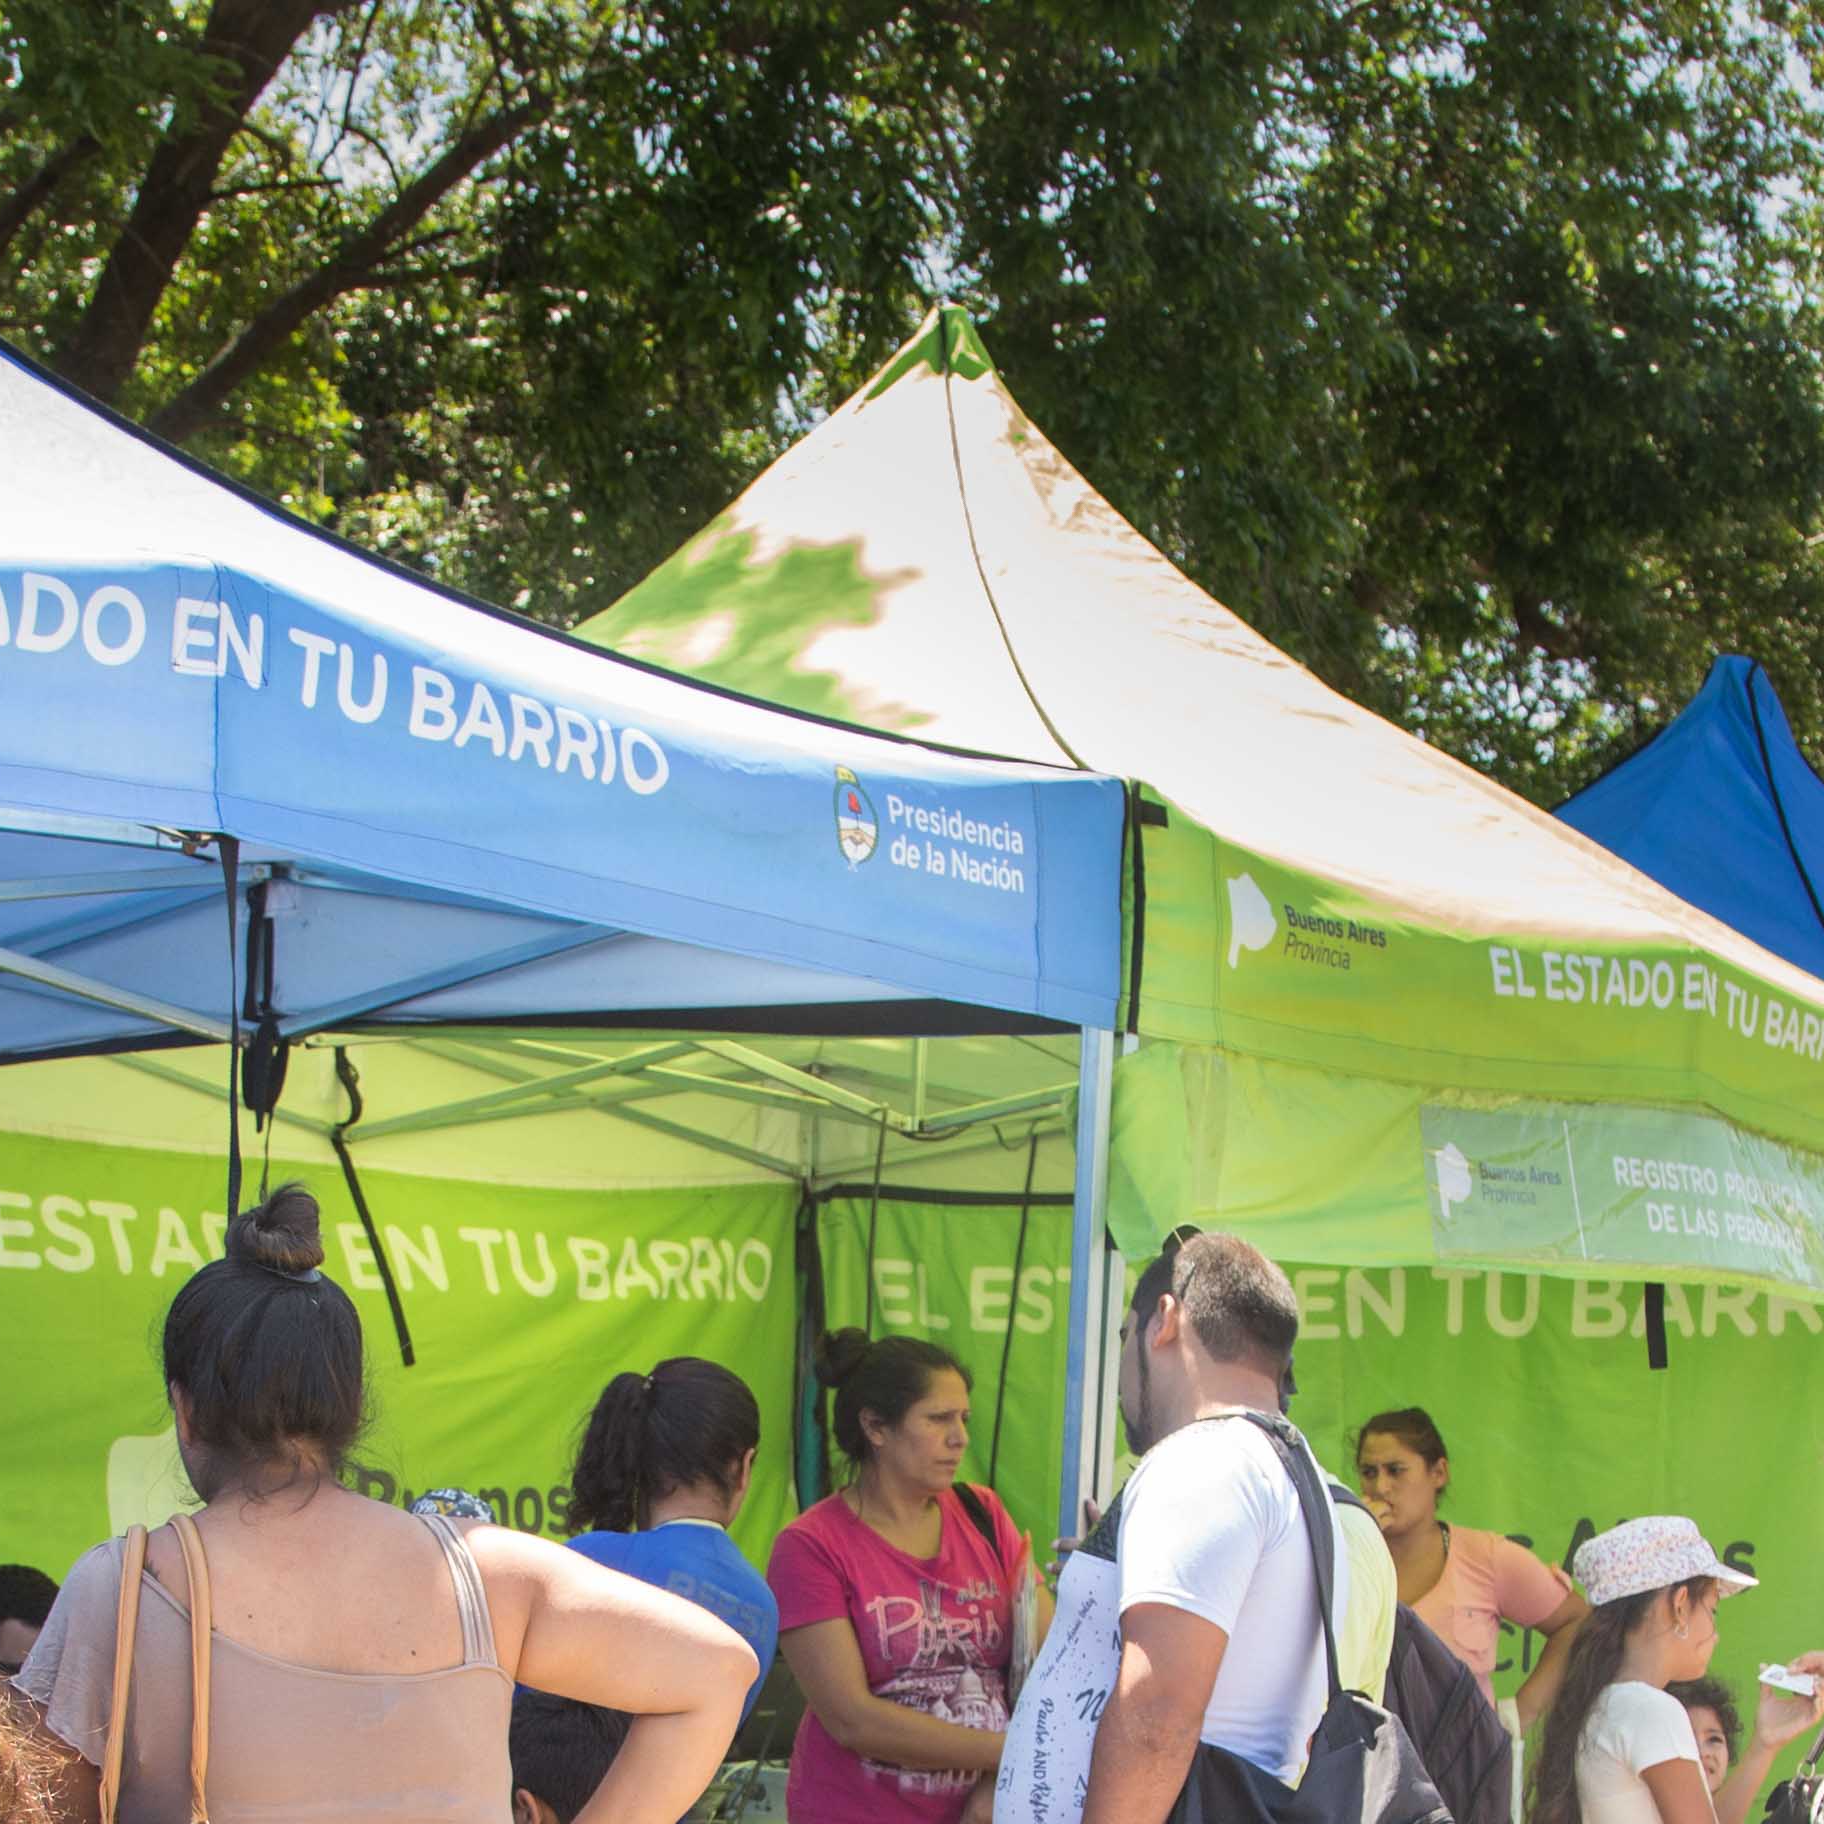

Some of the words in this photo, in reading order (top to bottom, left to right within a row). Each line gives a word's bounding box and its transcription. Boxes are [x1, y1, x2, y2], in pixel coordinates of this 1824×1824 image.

[171, 599, 266, 690] EN
[288, 627, 387, 723] TU
[409, 665, 670, 796] BARRIO
[886, 794, 1024, 855] Presidencia
[890, 834, 921, 869] de
[926, 841, 945, 876] la
[951, 847, 1024, 893] Nación
[1283, 931, 1352, 971] Provincia
[1284, 904, 1344, 941] Buenos
[1347, 919, 1387, 949] Aires
[1489, 945, 1536, 998] EL
[1542, 951, 1676, 1009] ESTADO
[1683, 963, 1717, 1017] EN
[1725, 980, 1760, 1038] TU
[1479, 1161, 1526, 1184] Buenos
[1613, 1156, 1719, 1196] REGISTRO
[1646, 1202, 1678, 1232] DE
[1682, 1206, 1719, 1239] LAS
[343, 1218, 450, 1293] EN
[458, 1226, 558, 1300] TU
[572, 1234, 772, 1304] BARRIO
[875, 1258, 950, 1330] EL
[1295, 1266, 1406, 1339] EN
[1431, 1267, 1539, 1337] TU
[1033, 1749, 1049, 1780] AND
